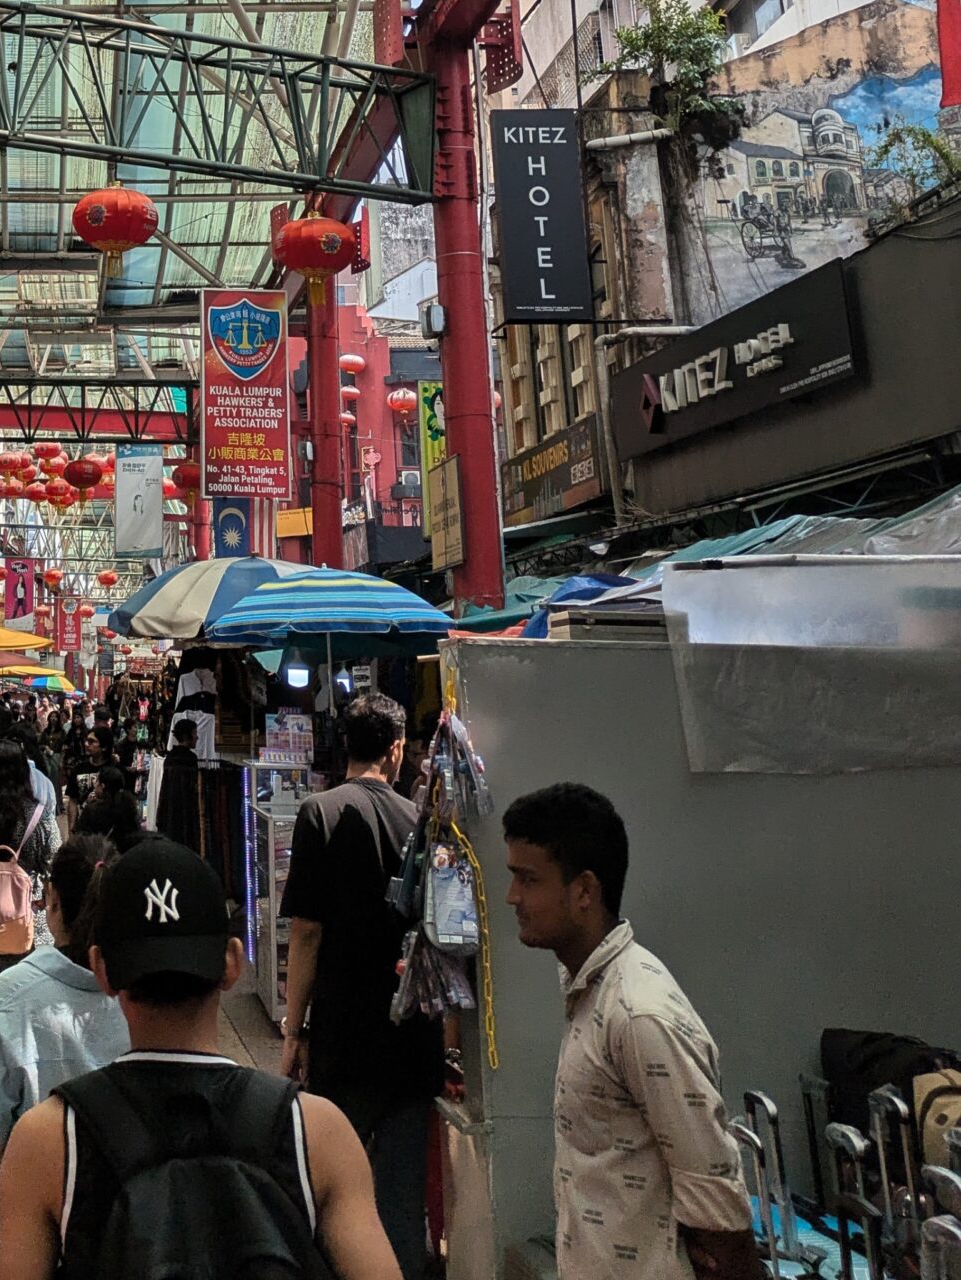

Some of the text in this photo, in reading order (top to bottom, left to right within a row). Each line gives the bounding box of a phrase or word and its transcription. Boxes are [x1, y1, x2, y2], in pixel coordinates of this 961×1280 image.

[504, 126, 567, 144] KITEZ
[527, 156, 556, 299] HOTEL
[659, 347, 733, 413] KITEZ
[734, 323, 794, 365] HOTEL
[209, 385, 282, 397] KUALA LUMPUR
[217, 396, 274, 408] HAWKERS' &
[207, 406, 285, 418] PETTY TRADERS'
[214, 417, 278, 429] ASSOCIATION
[227, 432, 266, 446] 吉隆坡
[208, 446, 285, 461] 小販商業公會
[532, 439, 569, 477] SOUVENIRS
[207, 464, 287, 477] No. 41-43, Tingkat 5,
[218, 475, 275, 485] Jalan Petaling,
[208, 483, 286, 495] 50000 Kuala Lumpur
[143, 878, 180, 923] NY
